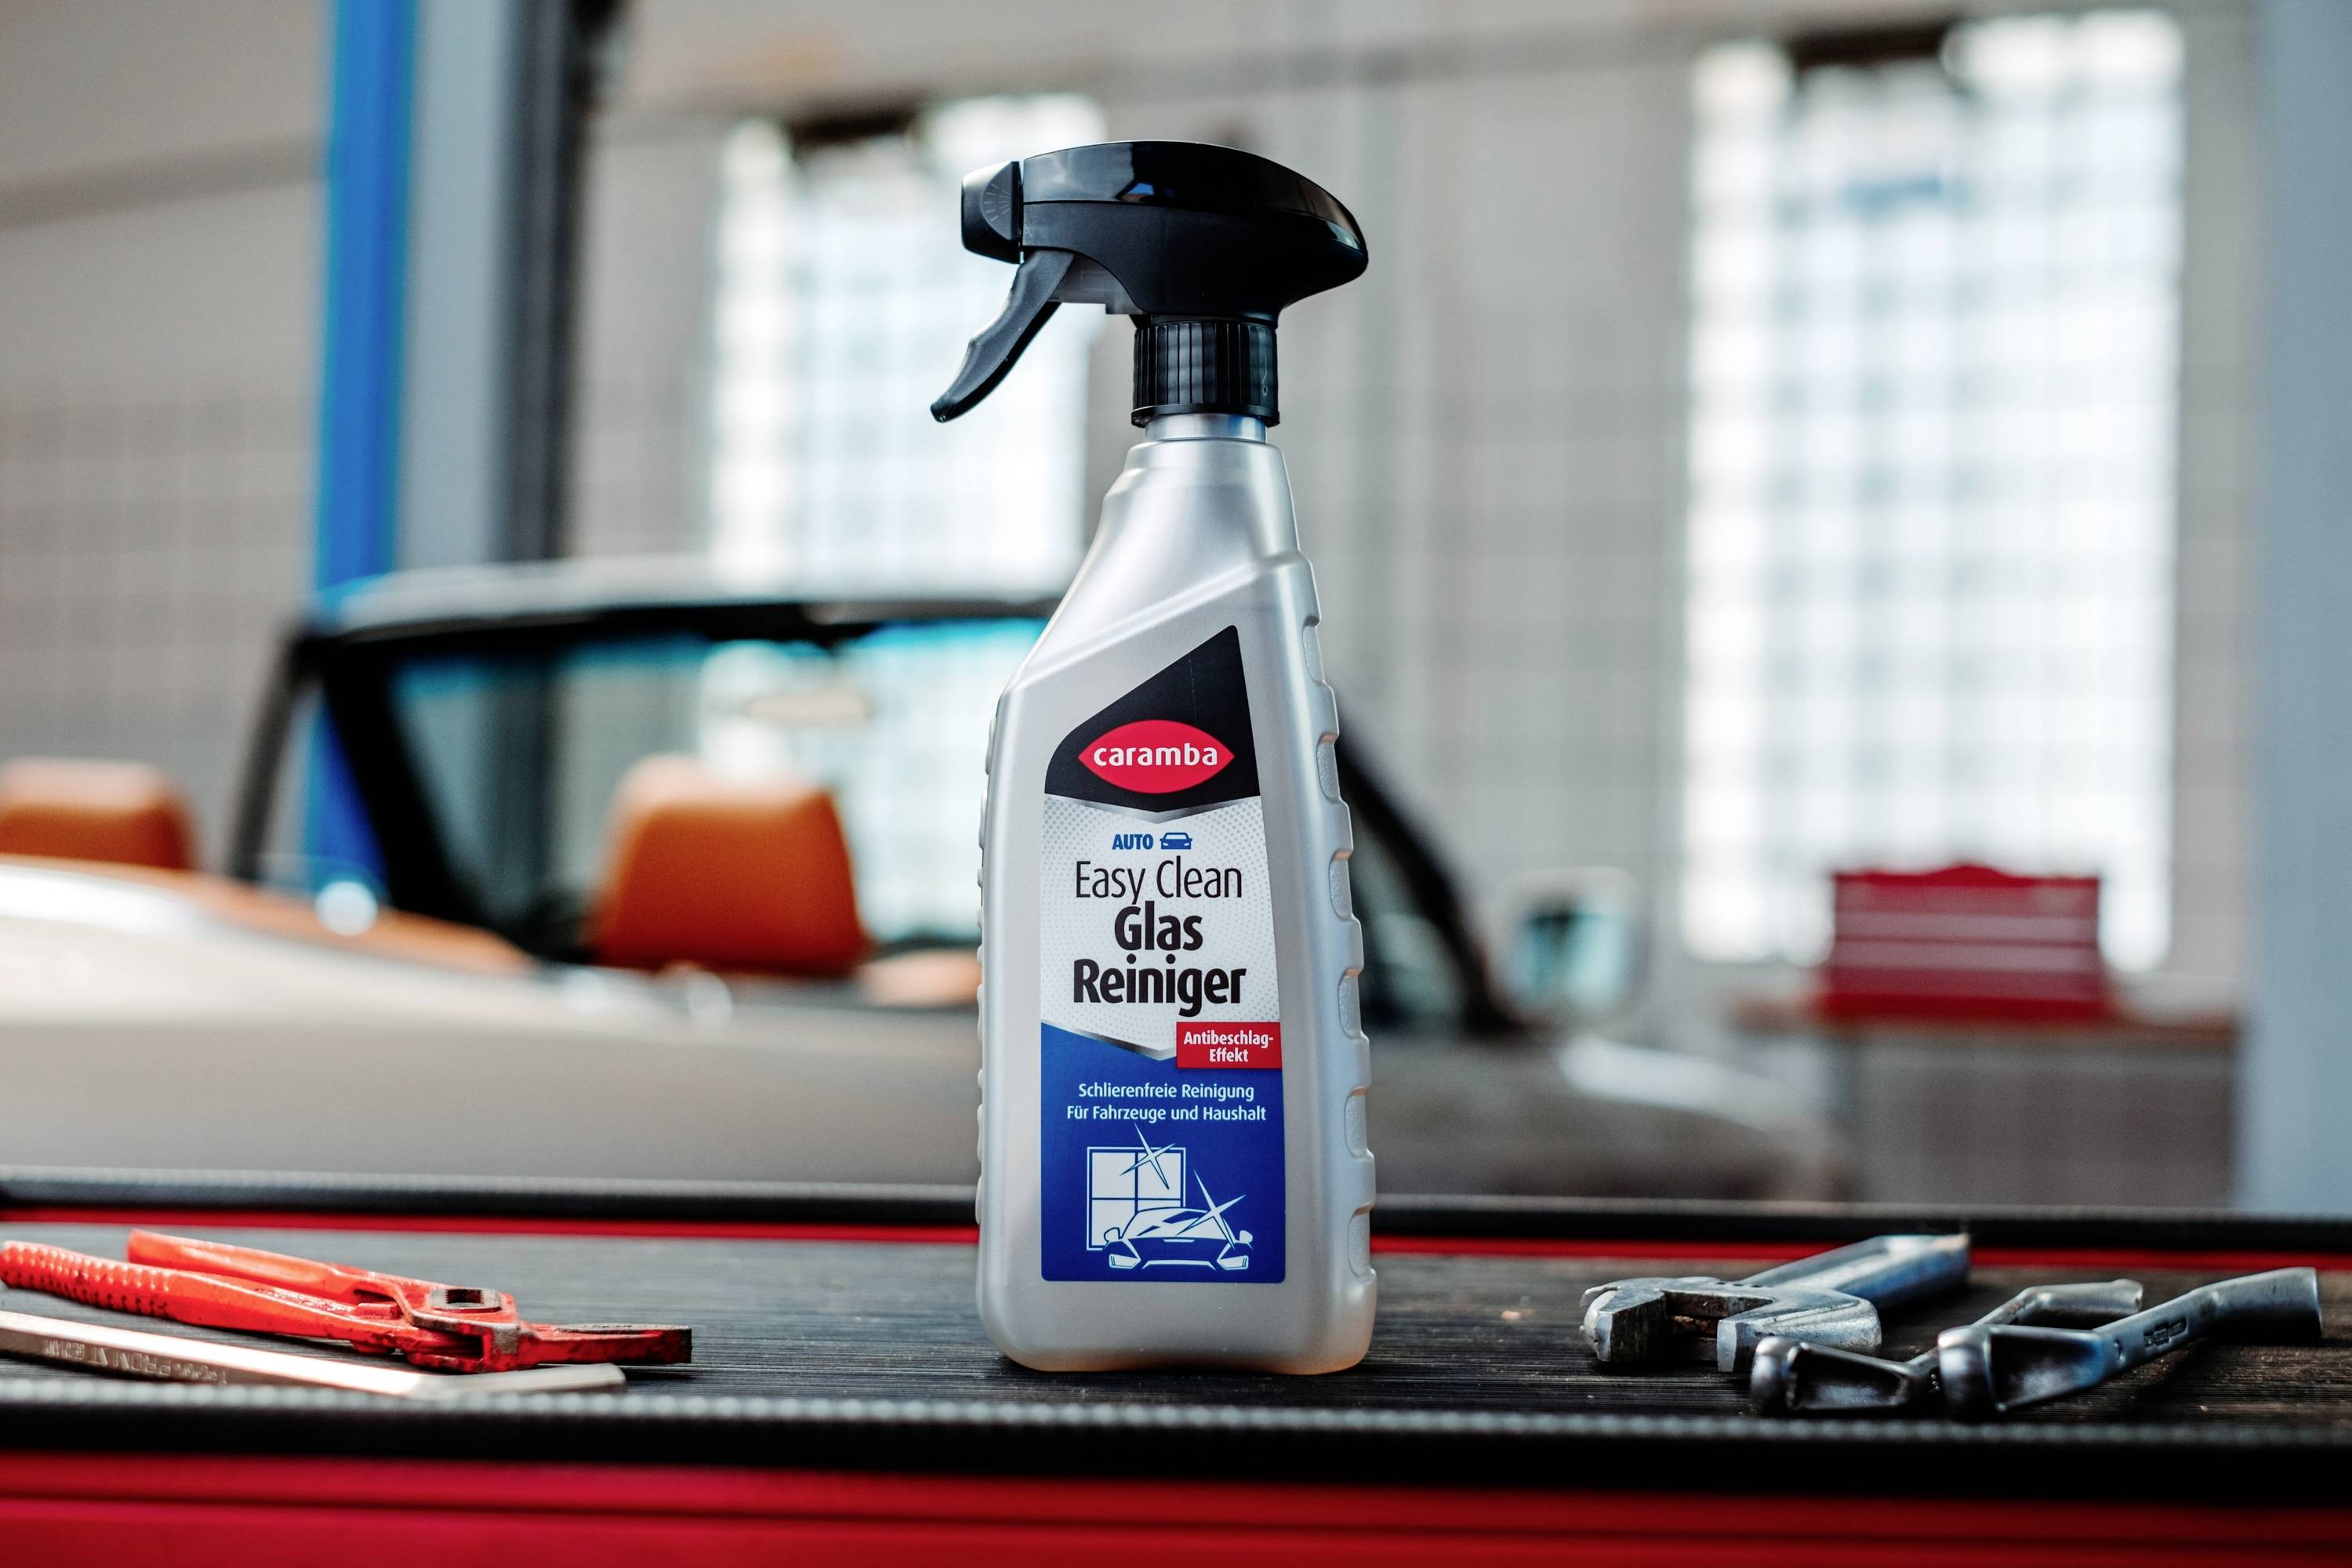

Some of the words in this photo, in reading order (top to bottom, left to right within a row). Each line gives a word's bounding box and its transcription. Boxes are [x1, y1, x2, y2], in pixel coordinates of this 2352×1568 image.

[1093, 743, 1218, 766] caramba
[1112, 833, 1154, 851] AUTO
[1076, 860, 1146, 905] Easy
[1156, 855, 1242, 898] Clean
[1114, 901, 1203, 951] Glas
[1073, 953, 1247, 1018] Reiniger
[1183, 1029, 1274, 1046] Antibeschlag-
[1209, 1047, 1249, 1063] Effekt
[1078, 1082, 1178, 1098] Schlierenfreie
[1181, 1083, 1254, 1101] Reinigung
[1067, 1105, 1089, 1120] Für
[1093, 1105, 1167, 1122] Fahrzeuge
[1171, 1105, 1199, 1120] und
[1203, 1105, 1266, 1121] Haushalt
